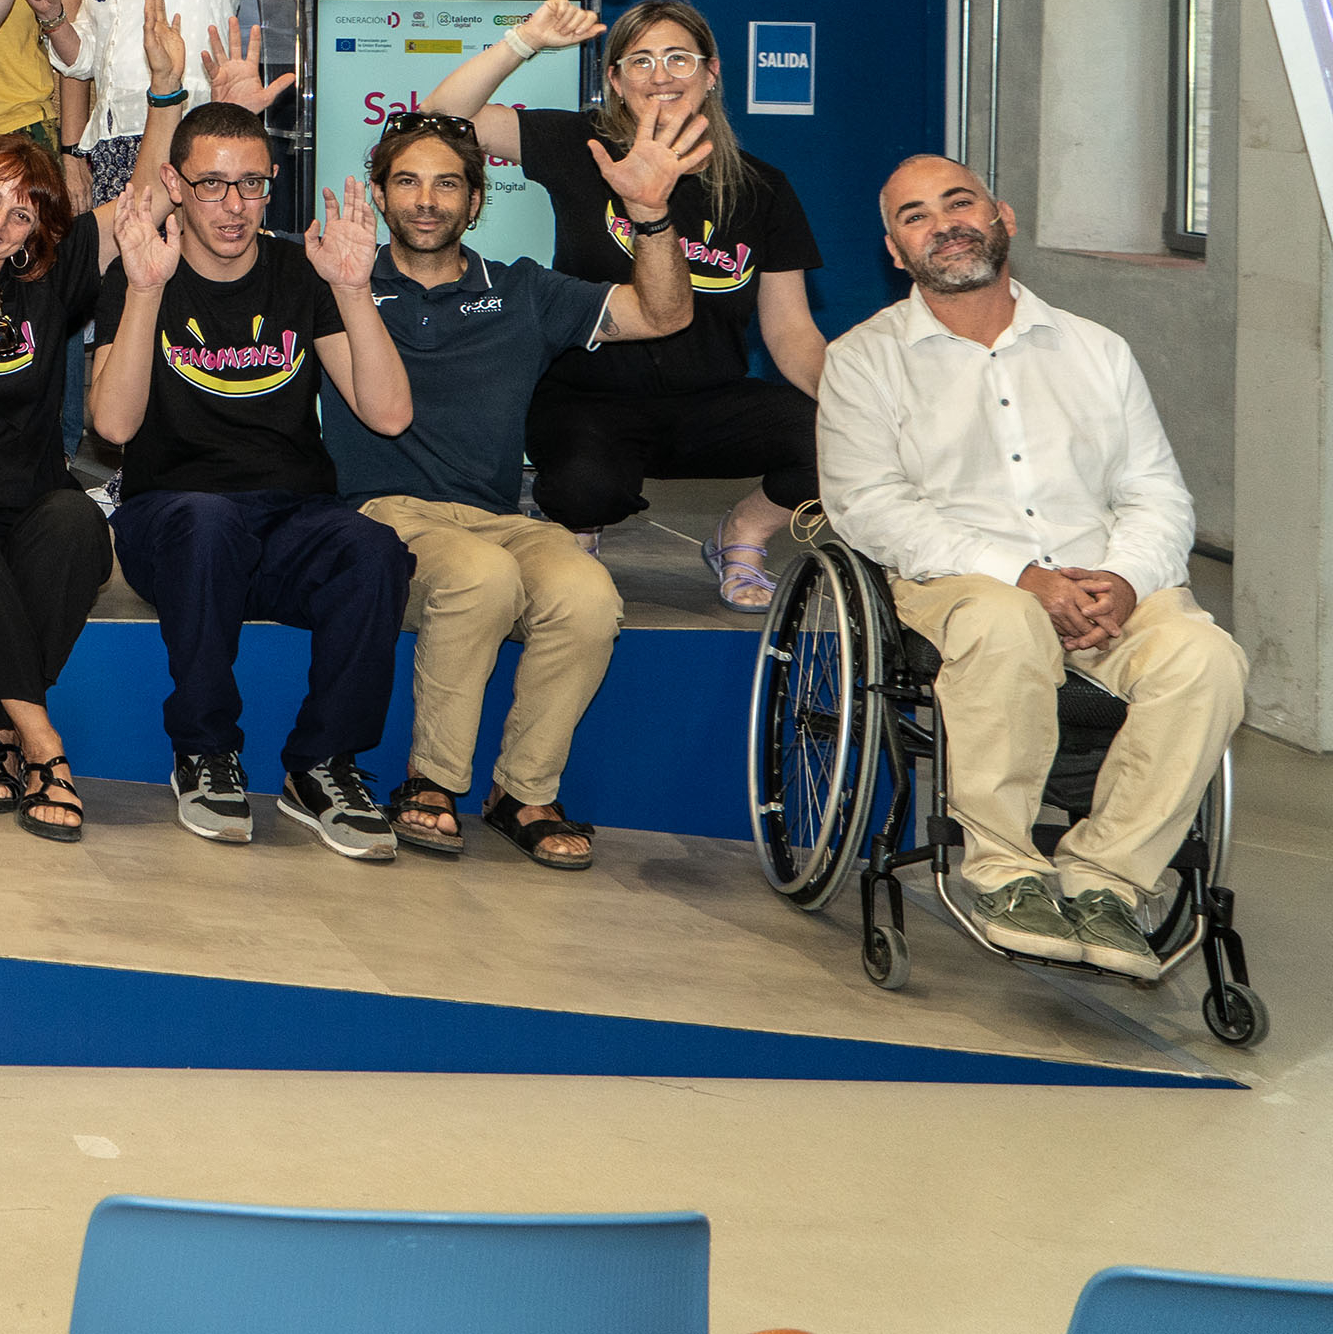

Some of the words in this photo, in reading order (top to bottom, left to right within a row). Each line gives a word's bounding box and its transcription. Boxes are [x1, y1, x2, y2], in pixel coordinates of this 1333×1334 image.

[451, 16, 482, 24] talento
[757, 52, 809, 68] SALIDA
[495, 181, 526, 194] Digital
